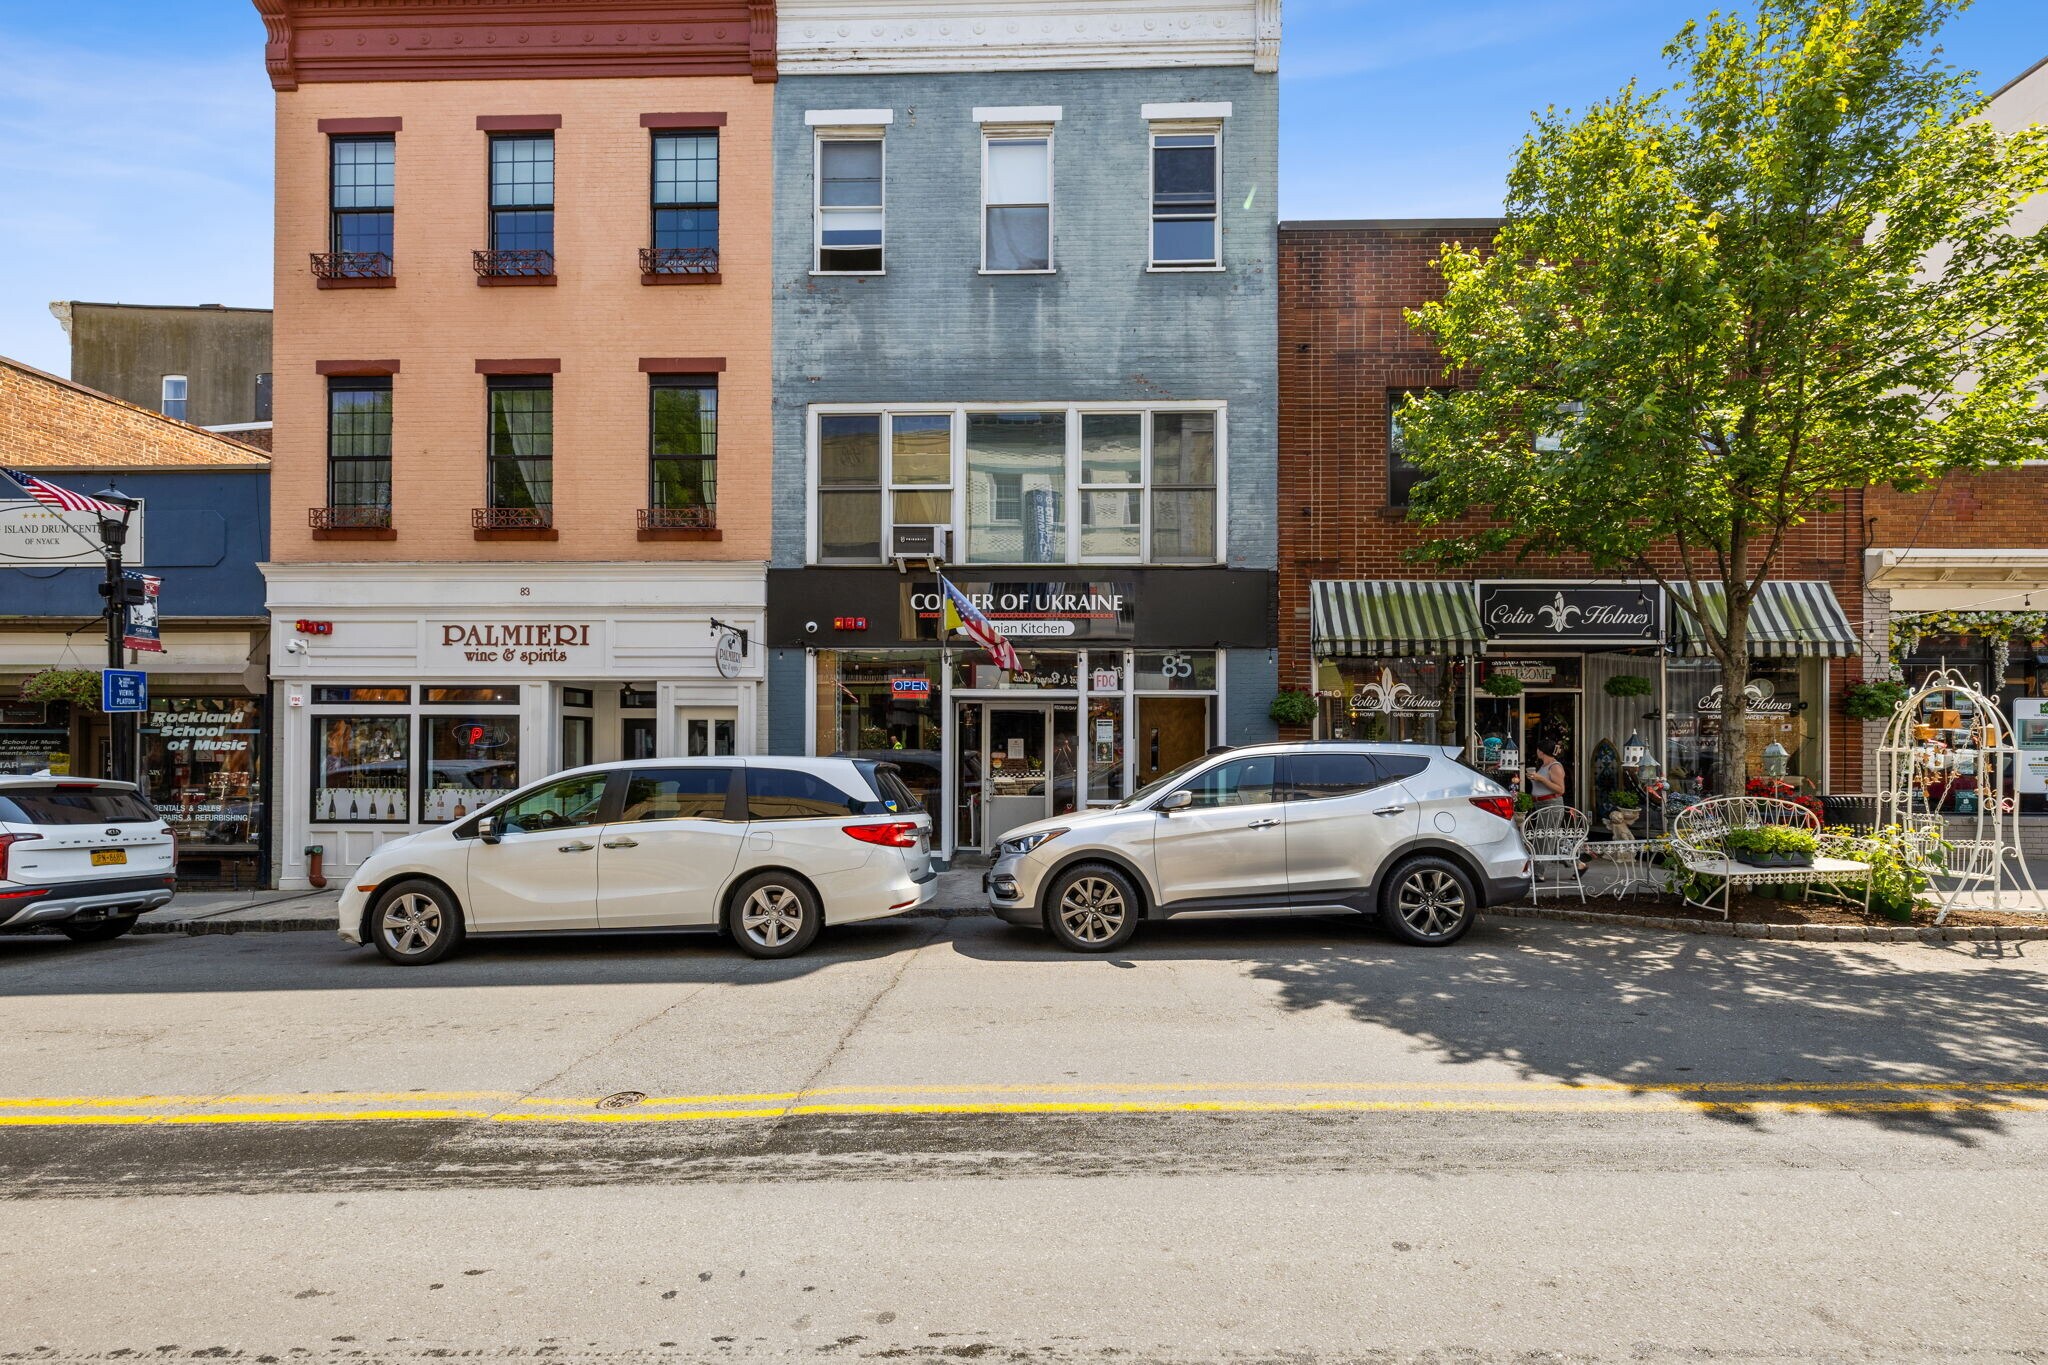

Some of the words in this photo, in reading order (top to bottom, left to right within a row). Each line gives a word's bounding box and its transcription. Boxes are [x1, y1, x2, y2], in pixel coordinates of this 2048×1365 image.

[4, 524, 39, 534] ISLAND
[41, 524, 69, 534] DRUM
[520, 587, 530, 596] 83
[910, 593, 994, 610] COER
[1000, 593, 1029, 611] OF
[1035, 593, 1123, 611] UKRAINE
[1490, 604, 1535, 624] Colin
[1581, 604, 1649, 624] Holmes
[1021, 622, 1065, 634] Kitchen
[442, 624, 590, 647] PALMIERI
[464, 648, 498, 662] wine
[502, 648, 516, 662] &
[519, 648, 567, 665] spirits
[1162, 654, 1192, 678] 85
[893, 680, 929, 690] OPEN
[1096, 674, 1115, 687] FDC
[1349, 693, 1379, 707] Colin
[1398, 694, 1441, 707] Holmes
[1697, 695, 1721, 709] Coli
[1746, 697, 1792, 709] Holmes
[152, 711, 245, 723] Rockland
[160, 725, 226, 737] School
[458, 727, 505, 745] OPEN
[167, 739, 190, 751] of
[193, 739, 248, 751] Music
[188, 804, 194, 812] &
[197, 804, 222, 812] SALES
